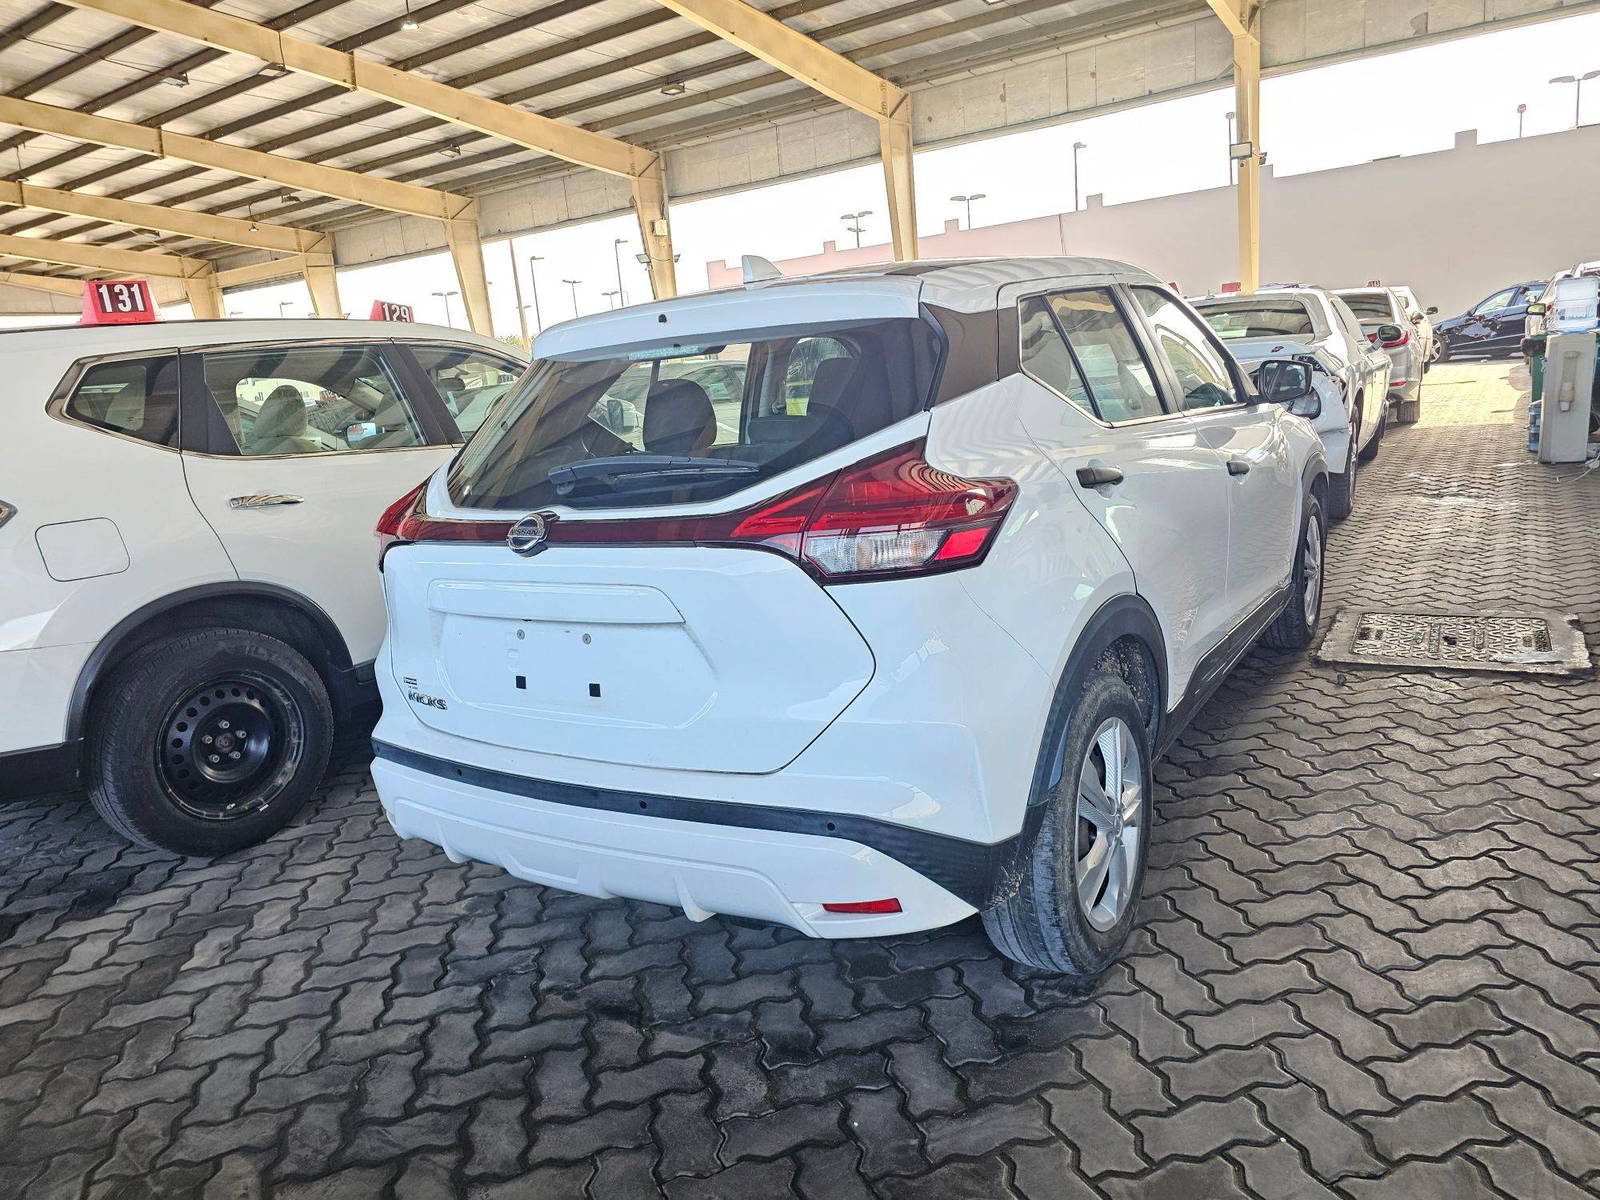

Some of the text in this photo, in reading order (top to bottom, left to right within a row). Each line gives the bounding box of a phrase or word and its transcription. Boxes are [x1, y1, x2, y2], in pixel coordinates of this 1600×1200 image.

[98, 283, 145, 313] 131
[382, 302, 411, 323] 129
[509, 527, 545, 537] NISSAN
[408, 690, 448, 711] KICKS
